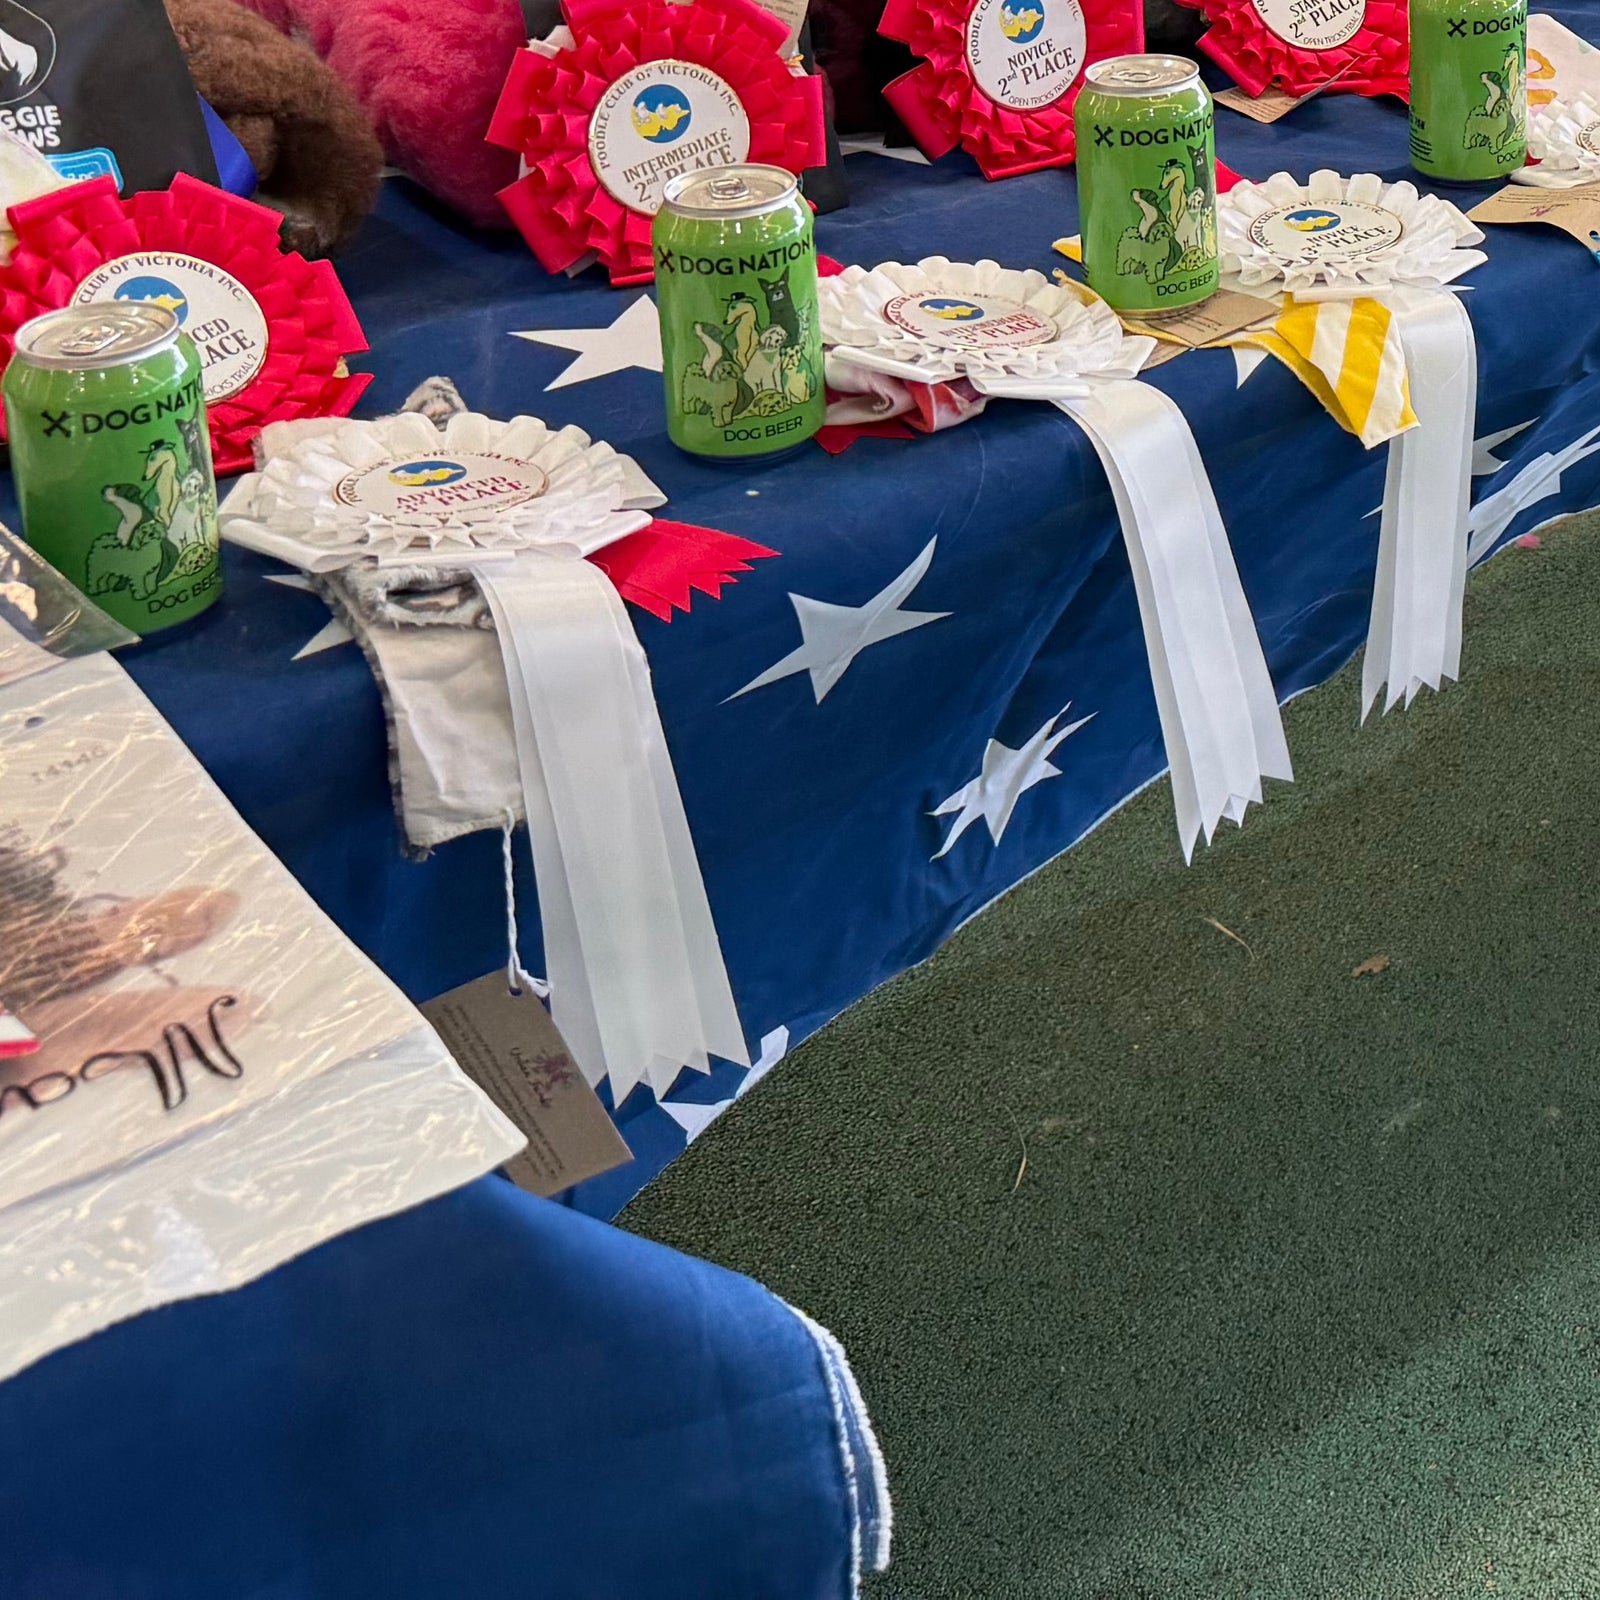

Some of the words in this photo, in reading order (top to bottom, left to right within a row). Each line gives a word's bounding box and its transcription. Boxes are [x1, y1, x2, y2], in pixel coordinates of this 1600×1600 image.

[971, 13, 983, 65] POODLE
[1289, 14, 1307, 39] 2nd
[1473, 17, 1511, 36] DOG
[1007, 38, 1057, 70] NOVICE
[998, 69, 1017, 97] 2nd
[1021, 47, 1076, 85] PLACE
[1008, 94, 1030, 106] OPEN
[1030, 91, 1055, 106] TRICKS
[1053, 77, 1072, 96] TRIAL
[594, 113, 612, 170] POODLE
[606, 78, 634, 109] CLUB
[636, 67, 653, 82] OF
[658, 64, 721, 92] VICTORIA
[1121, 128, 1169, 147] DOG
[1173, 114, 1215, 142] NATIO
[622, 128, 731, 183] INTERMEDIATE
[634, 173, 660, 202] 2nd
[1306, 224, 1360, 246] NOVICE
[1326, 226, 1393, 249] PLACE
[680, 255, 734, 275] DOG
[739, 234, 811, 275] NATION
[79, 273, 109, 304] CLUB
[109, 259, 129, 275] OF
[137, 255, 215, 279] VICTORIA
[1156, 281, 1187, 297] DOG
[1189, 270, 1214, 290] BEER
[982, 319, 1046, 338] PLACE
[201, 329, 256, 369] LACE
[232, 361, 254, 383] TRIAL
[252, 353, 259, 362] 2
[81, 403, 152, 435] DOG
[724, 426, 762, 442] DOG
[765, 415, 804, 438] BEER
[396, 475, 507, 505] ADVANCED
[435, 480, 531, 507] PLACE
[148, 590, 189, 615] DOG
